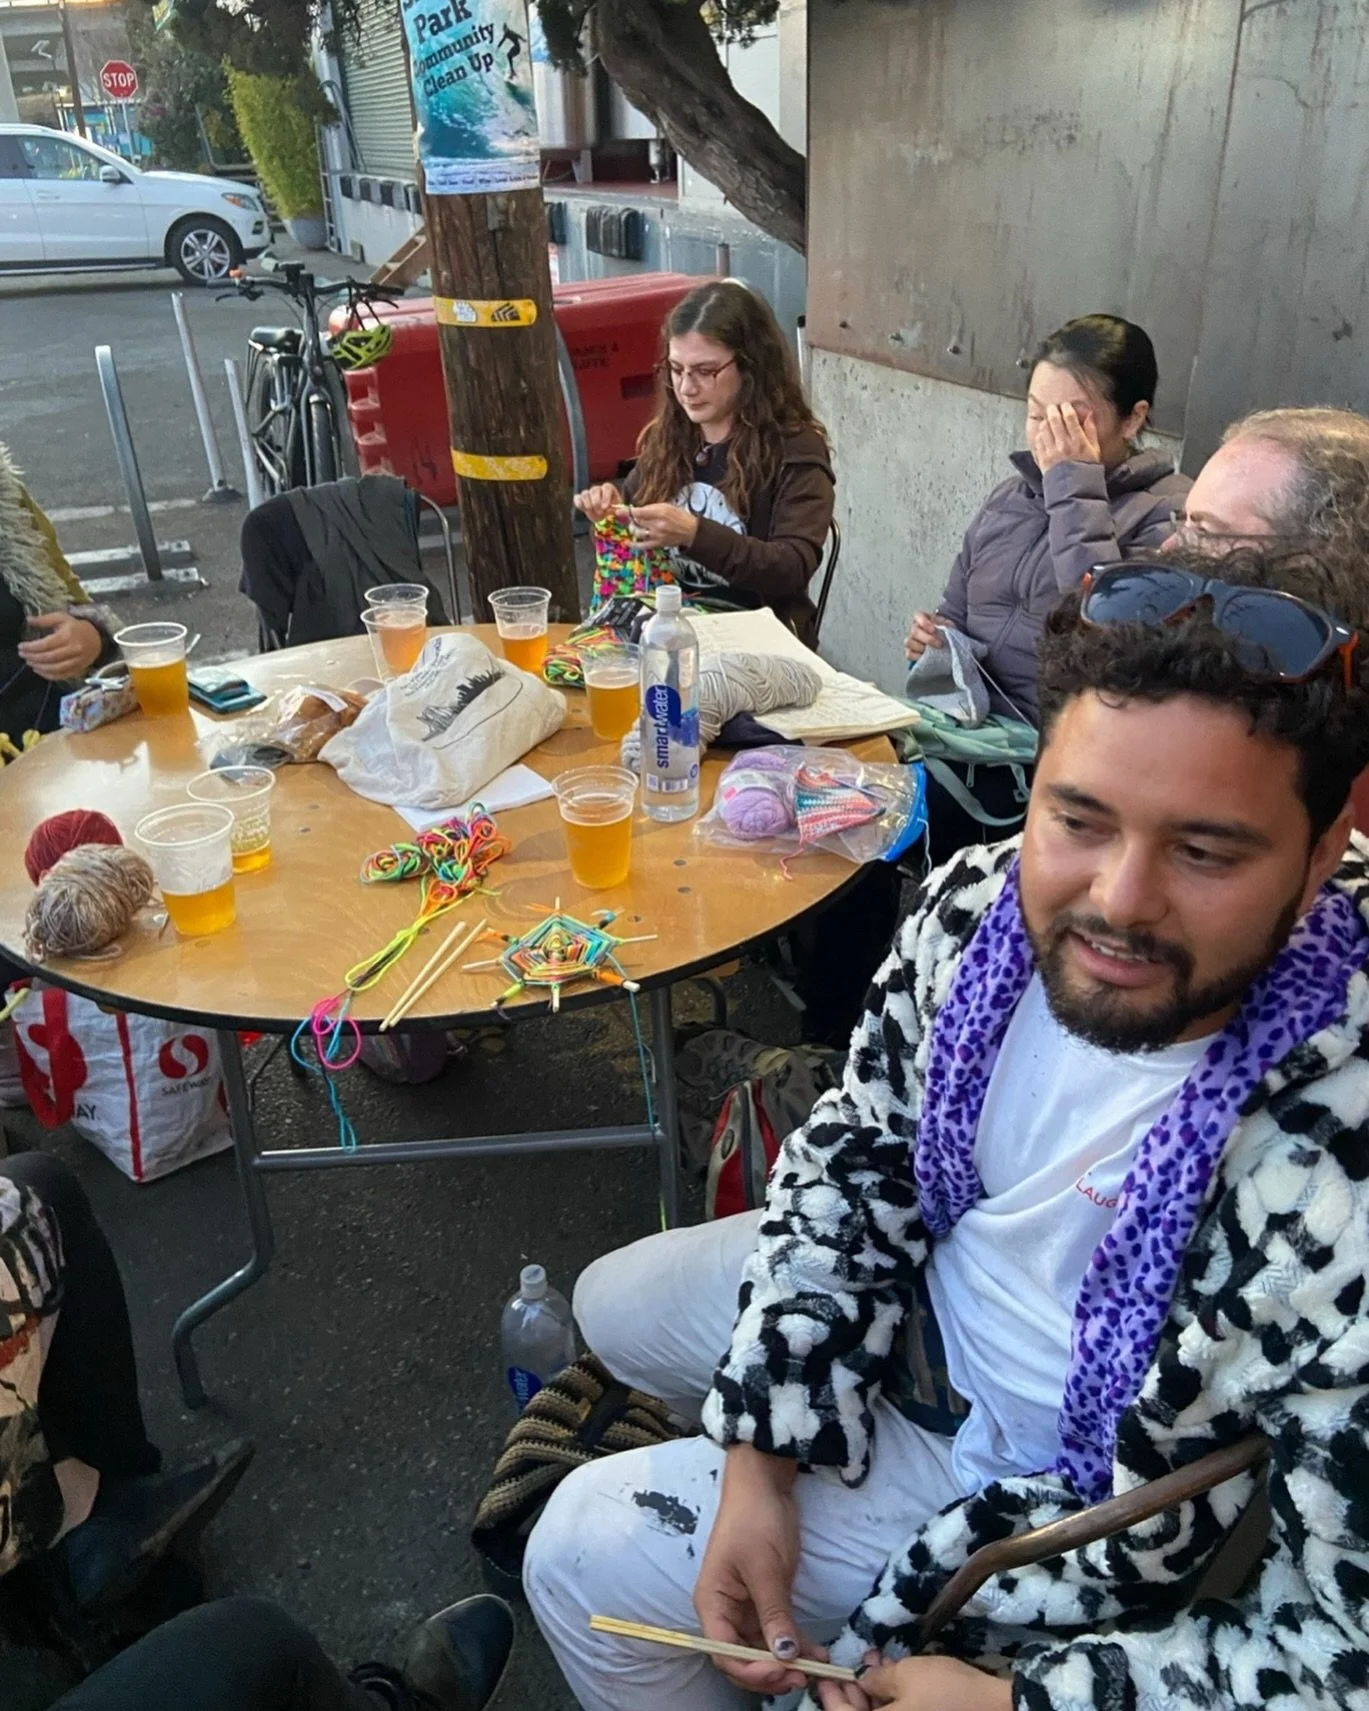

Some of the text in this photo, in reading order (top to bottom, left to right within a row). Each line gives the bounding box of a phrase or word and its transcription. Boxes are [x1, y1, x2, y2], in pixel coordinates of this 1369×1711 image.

[414, 0, 472, 44] Park
[103, 72, 134, 87] STOP
[423, 52, 493, 96] Clean Up
[653, 684, 669, 769] smartwater
[1076, 1177, 1118, 1209] LAUG
